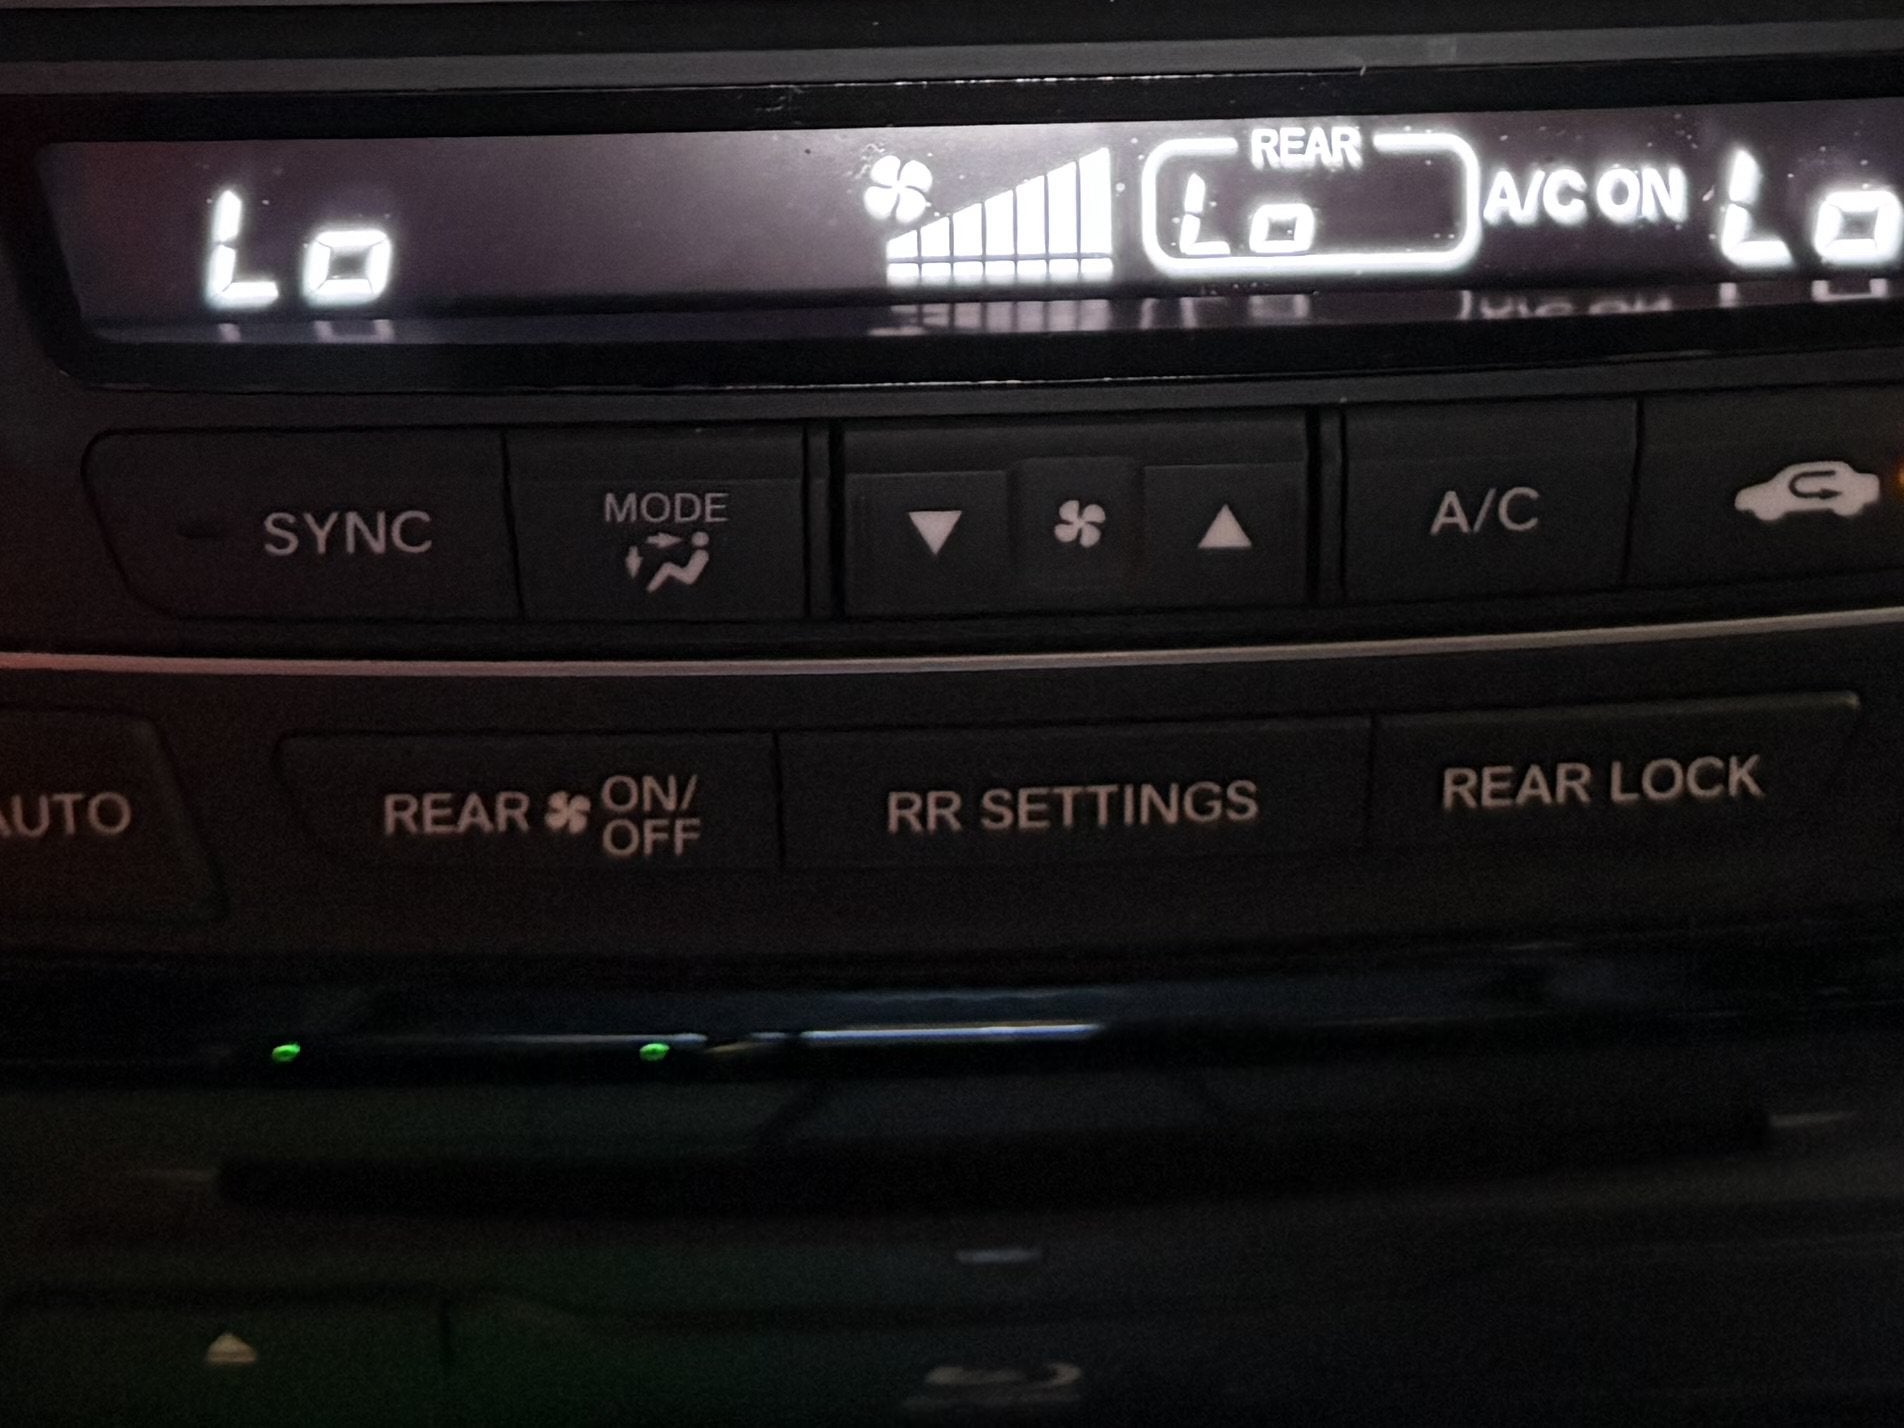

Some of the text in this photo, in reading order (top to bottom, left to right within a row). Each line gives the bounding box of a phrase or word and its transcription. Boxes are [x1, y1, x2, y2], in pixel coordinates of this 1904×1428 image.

[1248, 123, 1363, 171] REAR
[1482, 161, 1688, 226] A/C ON
[204, 187, 396, 310] Lo
[263, 509, 433, 557] SYNC
[603, 491, 728, 525] MODE
[1430, 485, 1540, 536] A/C
[383, 774, 698, 836] REAR ON/
[887, 779, 1260, 834] RR SETTINGS
[1442, 754, 1763, 810] REAR LOCK
[601, 817, 701, 858] OFF
